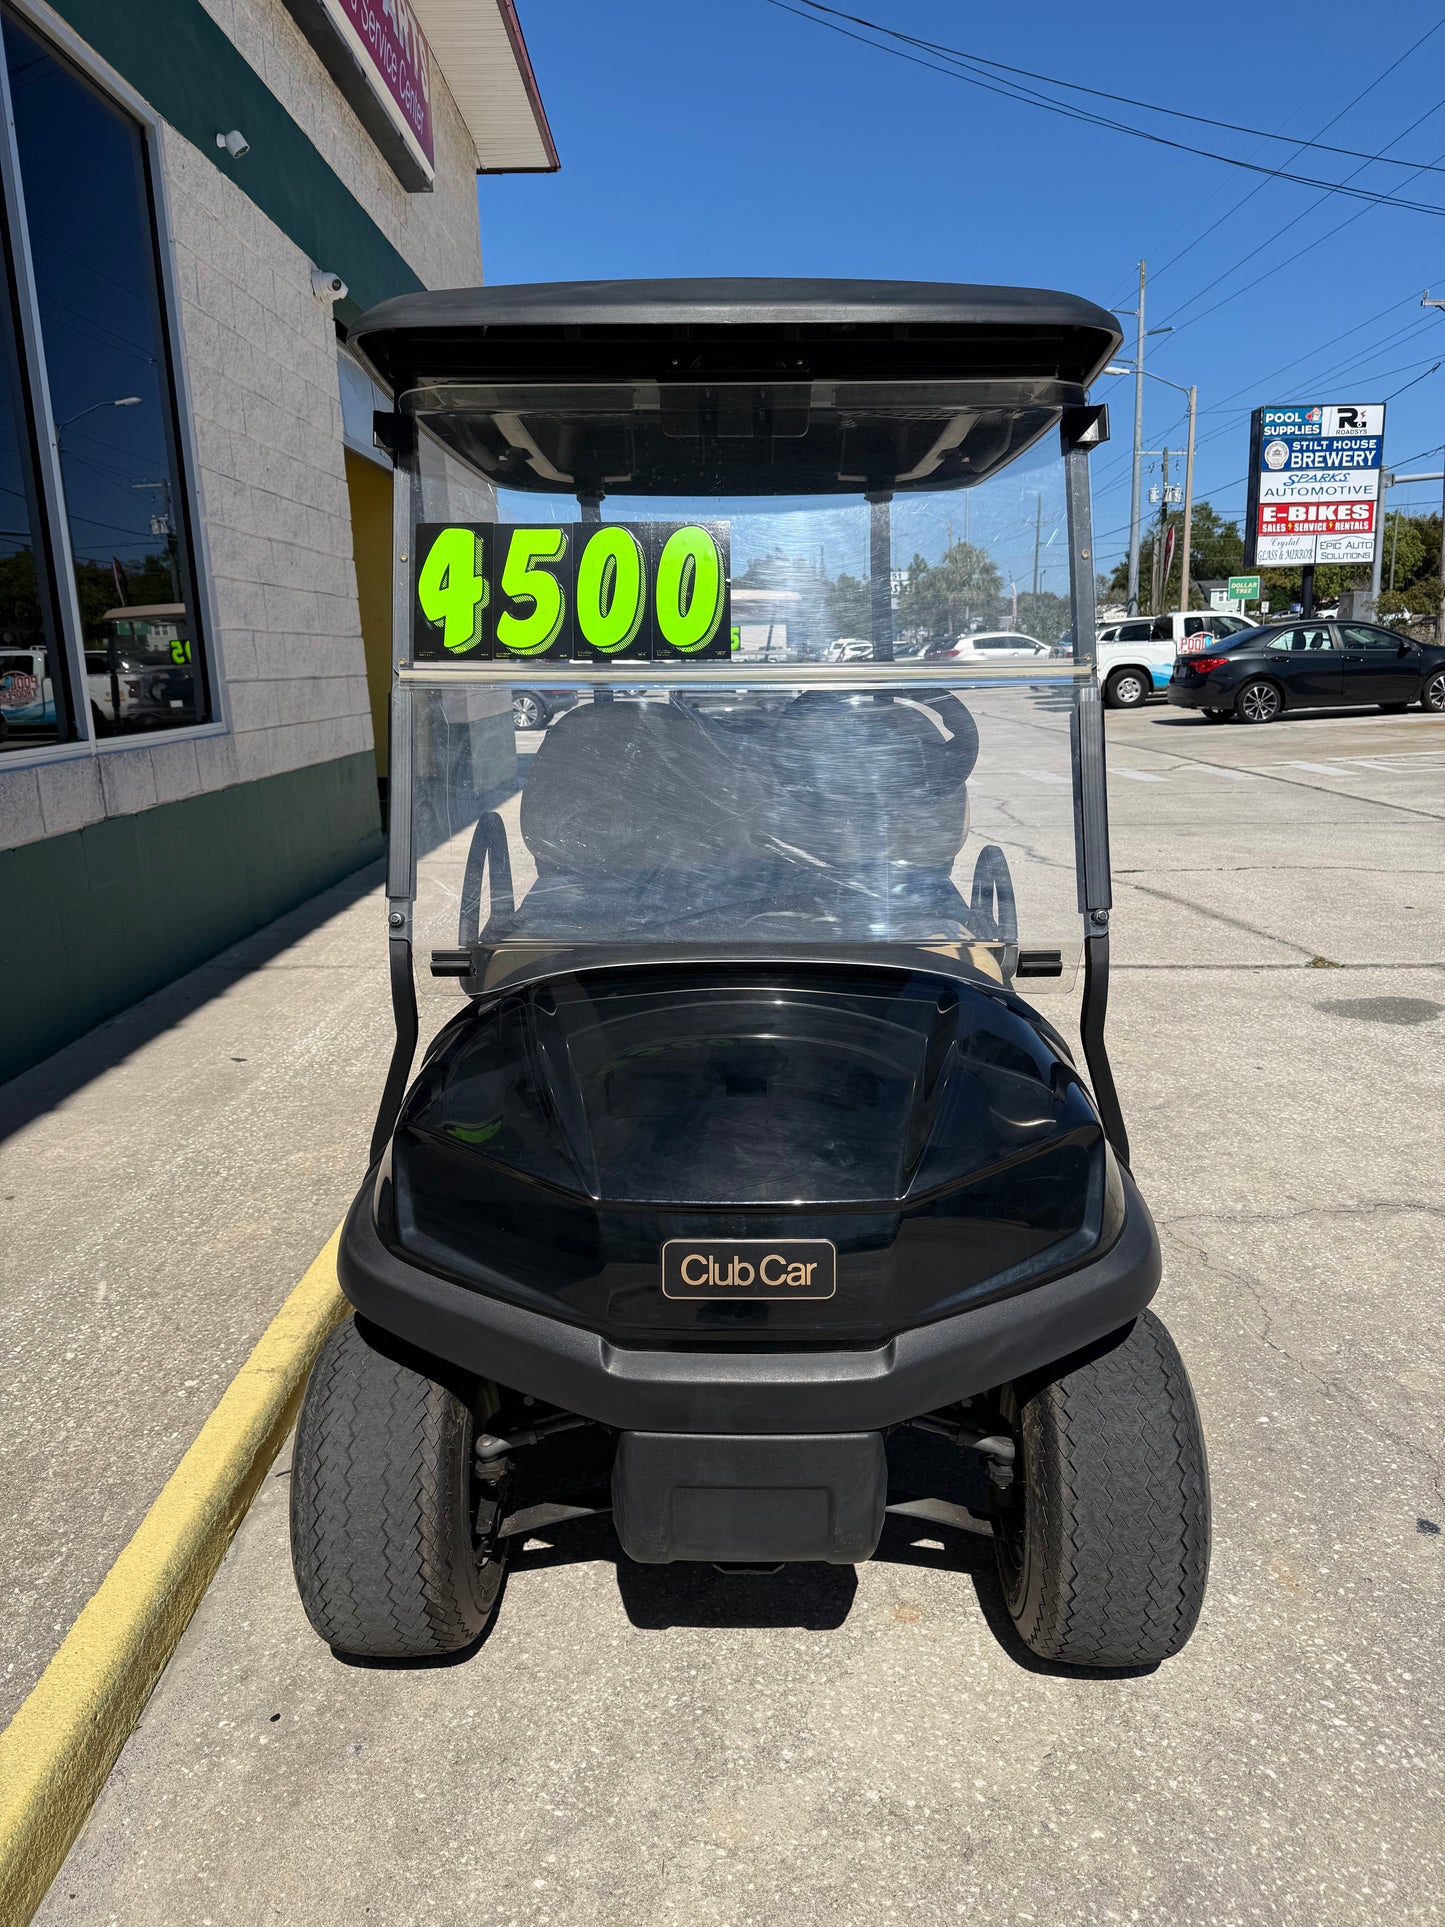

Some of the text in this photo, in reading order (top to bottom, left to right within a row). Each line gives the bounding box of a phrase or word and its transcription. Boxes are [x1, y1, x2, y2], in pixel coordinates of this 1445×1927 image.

[360, 0, 424, 135] Service Center
[1265, 412, 1302, 423] POOL
[1264, 424, 1320, 435] SUPPLIES
[1292, 439, 1377, 450] STILT HOUSE
[1290, 450, 1377, 468] BREWERY
[1264, 485, 1373, 497] AUTOMOTIVE
[1262, 504, 1370, 522] E-BIKES
[1262, 521, 1369, 533] SALES SERVICE RENTALS
[1345, 540, 1374, 550] AUTO
[1257, 549, 1279, 562] GLASS
[1284, 548, 1314, 560] MIRROR
[1320, 551, 1371, 560] SOLUTIONS
[418, 524, 727, 655] 4500
[680, 1254, 817, 1286] Club Car
